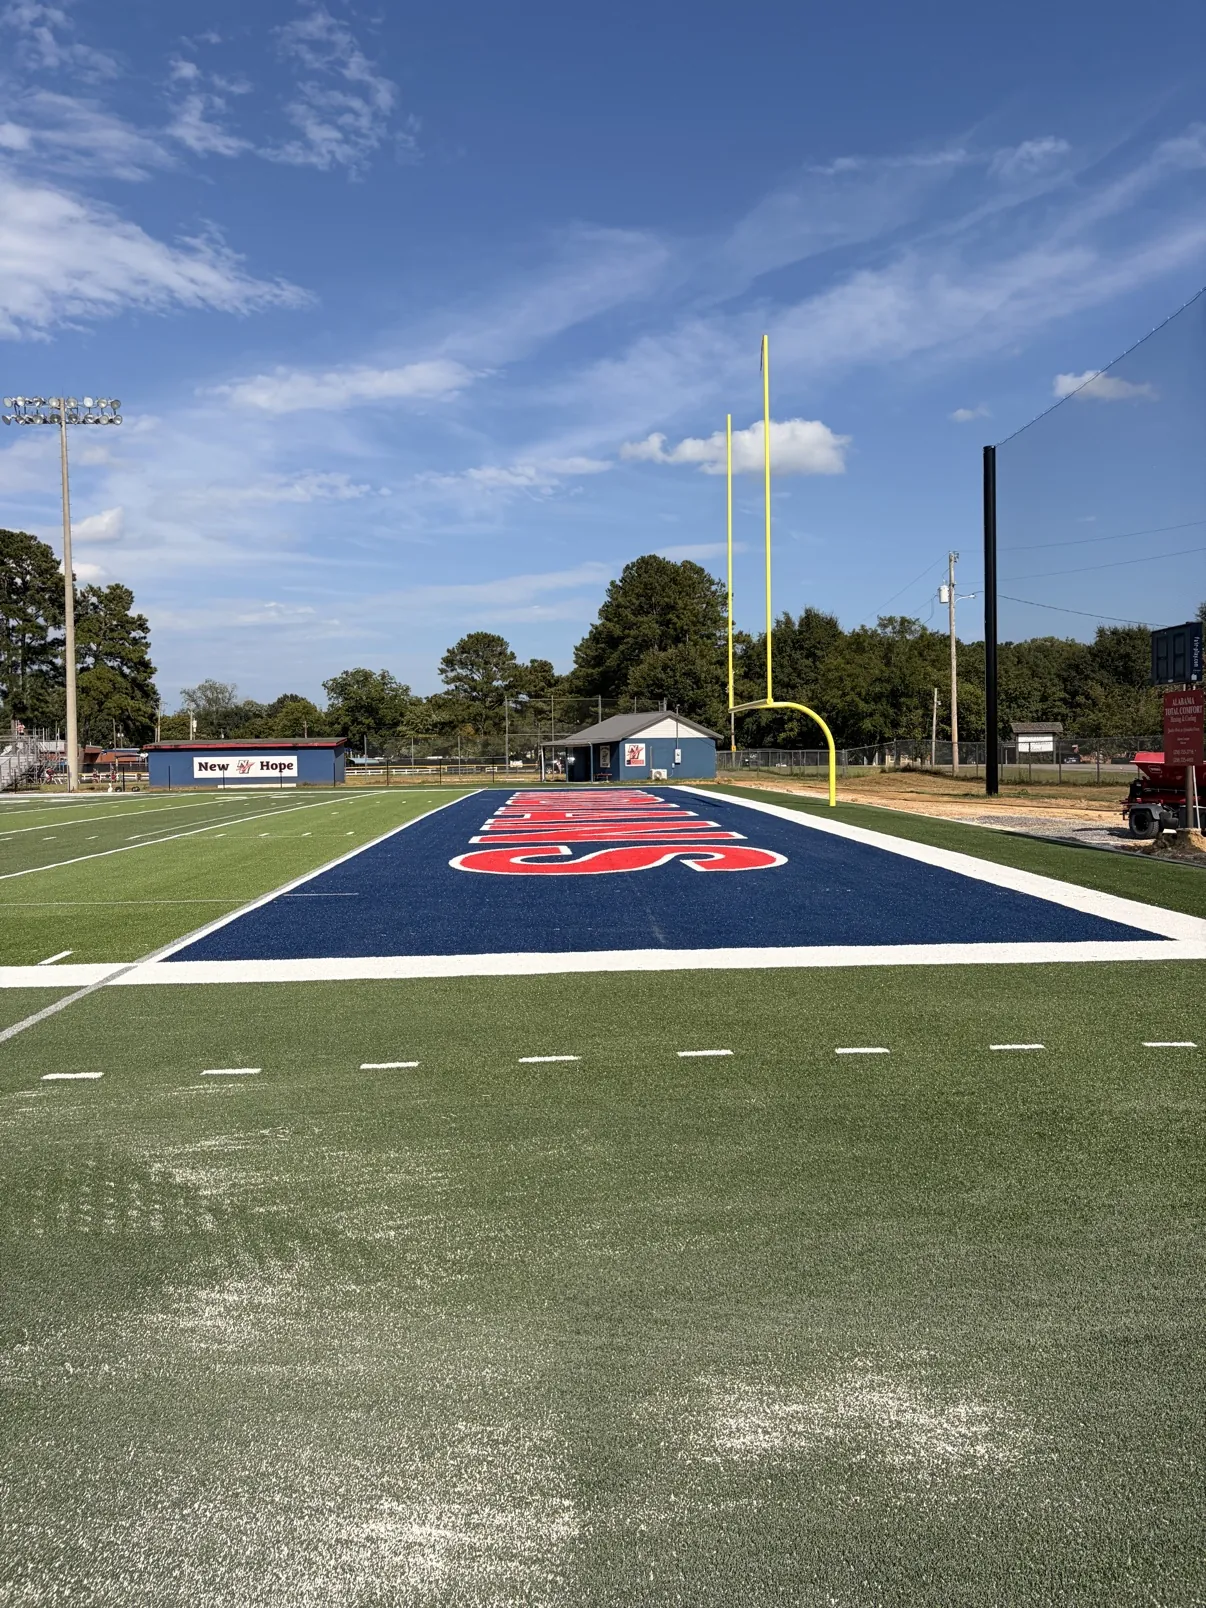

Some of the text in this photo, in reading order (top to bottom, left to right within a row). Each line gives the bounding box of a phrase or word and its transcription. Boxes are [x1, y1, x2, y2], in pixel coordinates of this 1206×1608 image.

[1172, 697, 1195, 706] ALABAMA
[1165, 705, 1203, 716] TOTAL COMFORT
[198, 762, 230, 772] New
[260, 761, 294, 773] Hope
